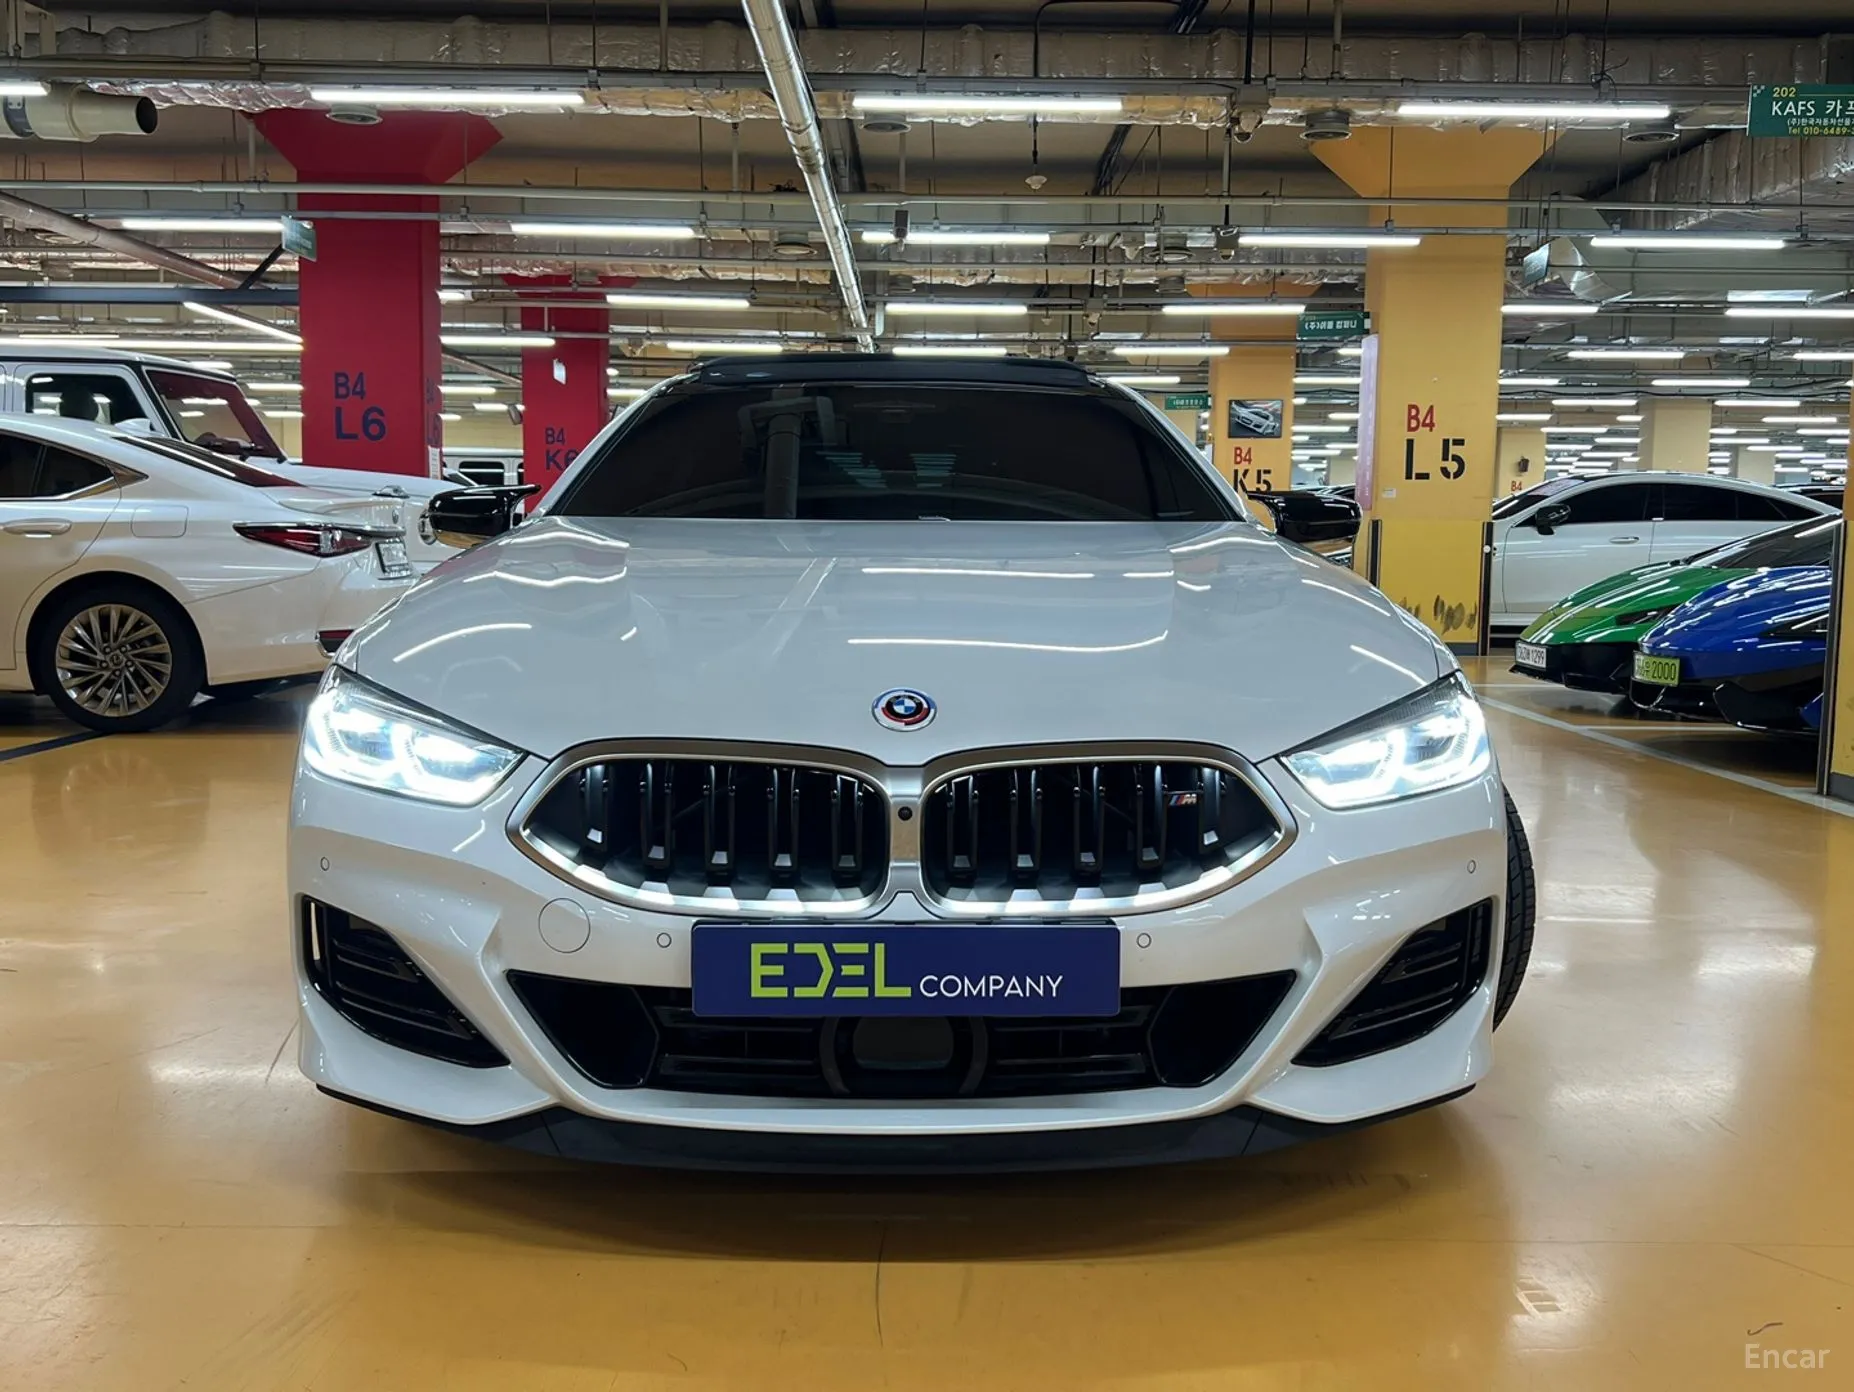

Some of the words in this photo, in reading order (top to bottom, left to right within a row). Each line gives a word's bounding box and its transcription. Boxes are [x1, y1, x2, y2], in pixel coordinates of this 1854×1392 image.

[1772, 87, 1796, 98] 202
[1771, 100, 1816, 116] KAFS
[1788, 126, 1800, 135] Tel
[334, 371, 365, 400] B4
[335, 405, 386, 442] L6
[1407, 403, 1436, 432] B4
[545, 427, 566, 445] B4
[1233, 446, 1252, 465] B4
[1511, 480, 1522, 491] B4
[1652, 660, 1677, 681] 2000
[751, 942, 912, 998] EDEL
[919, 974, 1063, 998] COMPANY
